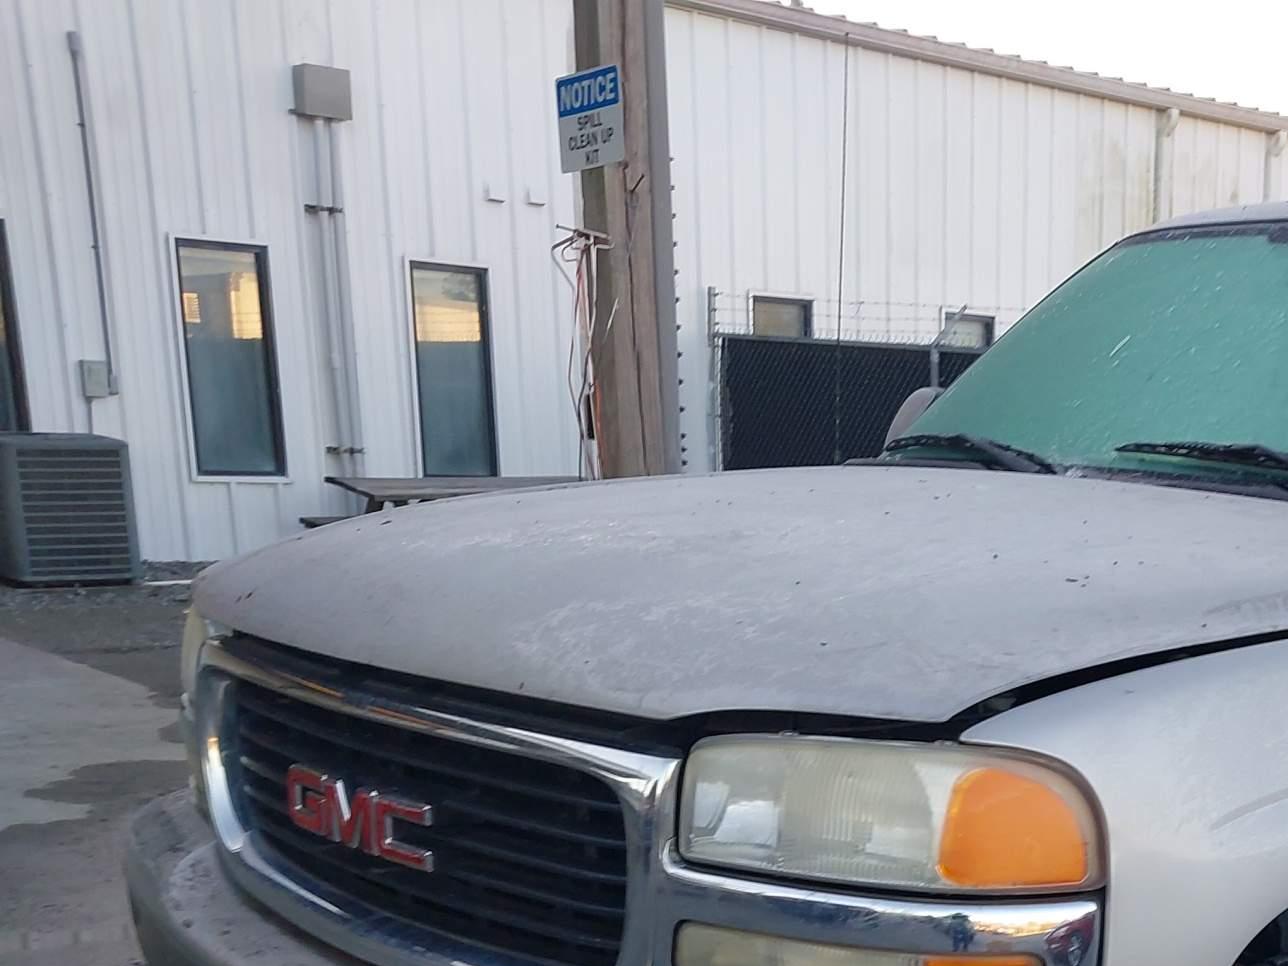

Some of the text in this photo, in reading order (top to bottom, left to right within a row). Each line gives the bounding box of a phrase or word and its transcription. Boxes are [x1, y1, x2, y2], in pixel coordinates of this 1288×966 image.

[560, 72, 616, 112] NOTICE
[577, 112, 602, 131] SPILL
[568, 127, 614, 151] CLEAN UP
[585, 149, 599, 165] KIT
[288, 764, 434, 872] GMC
